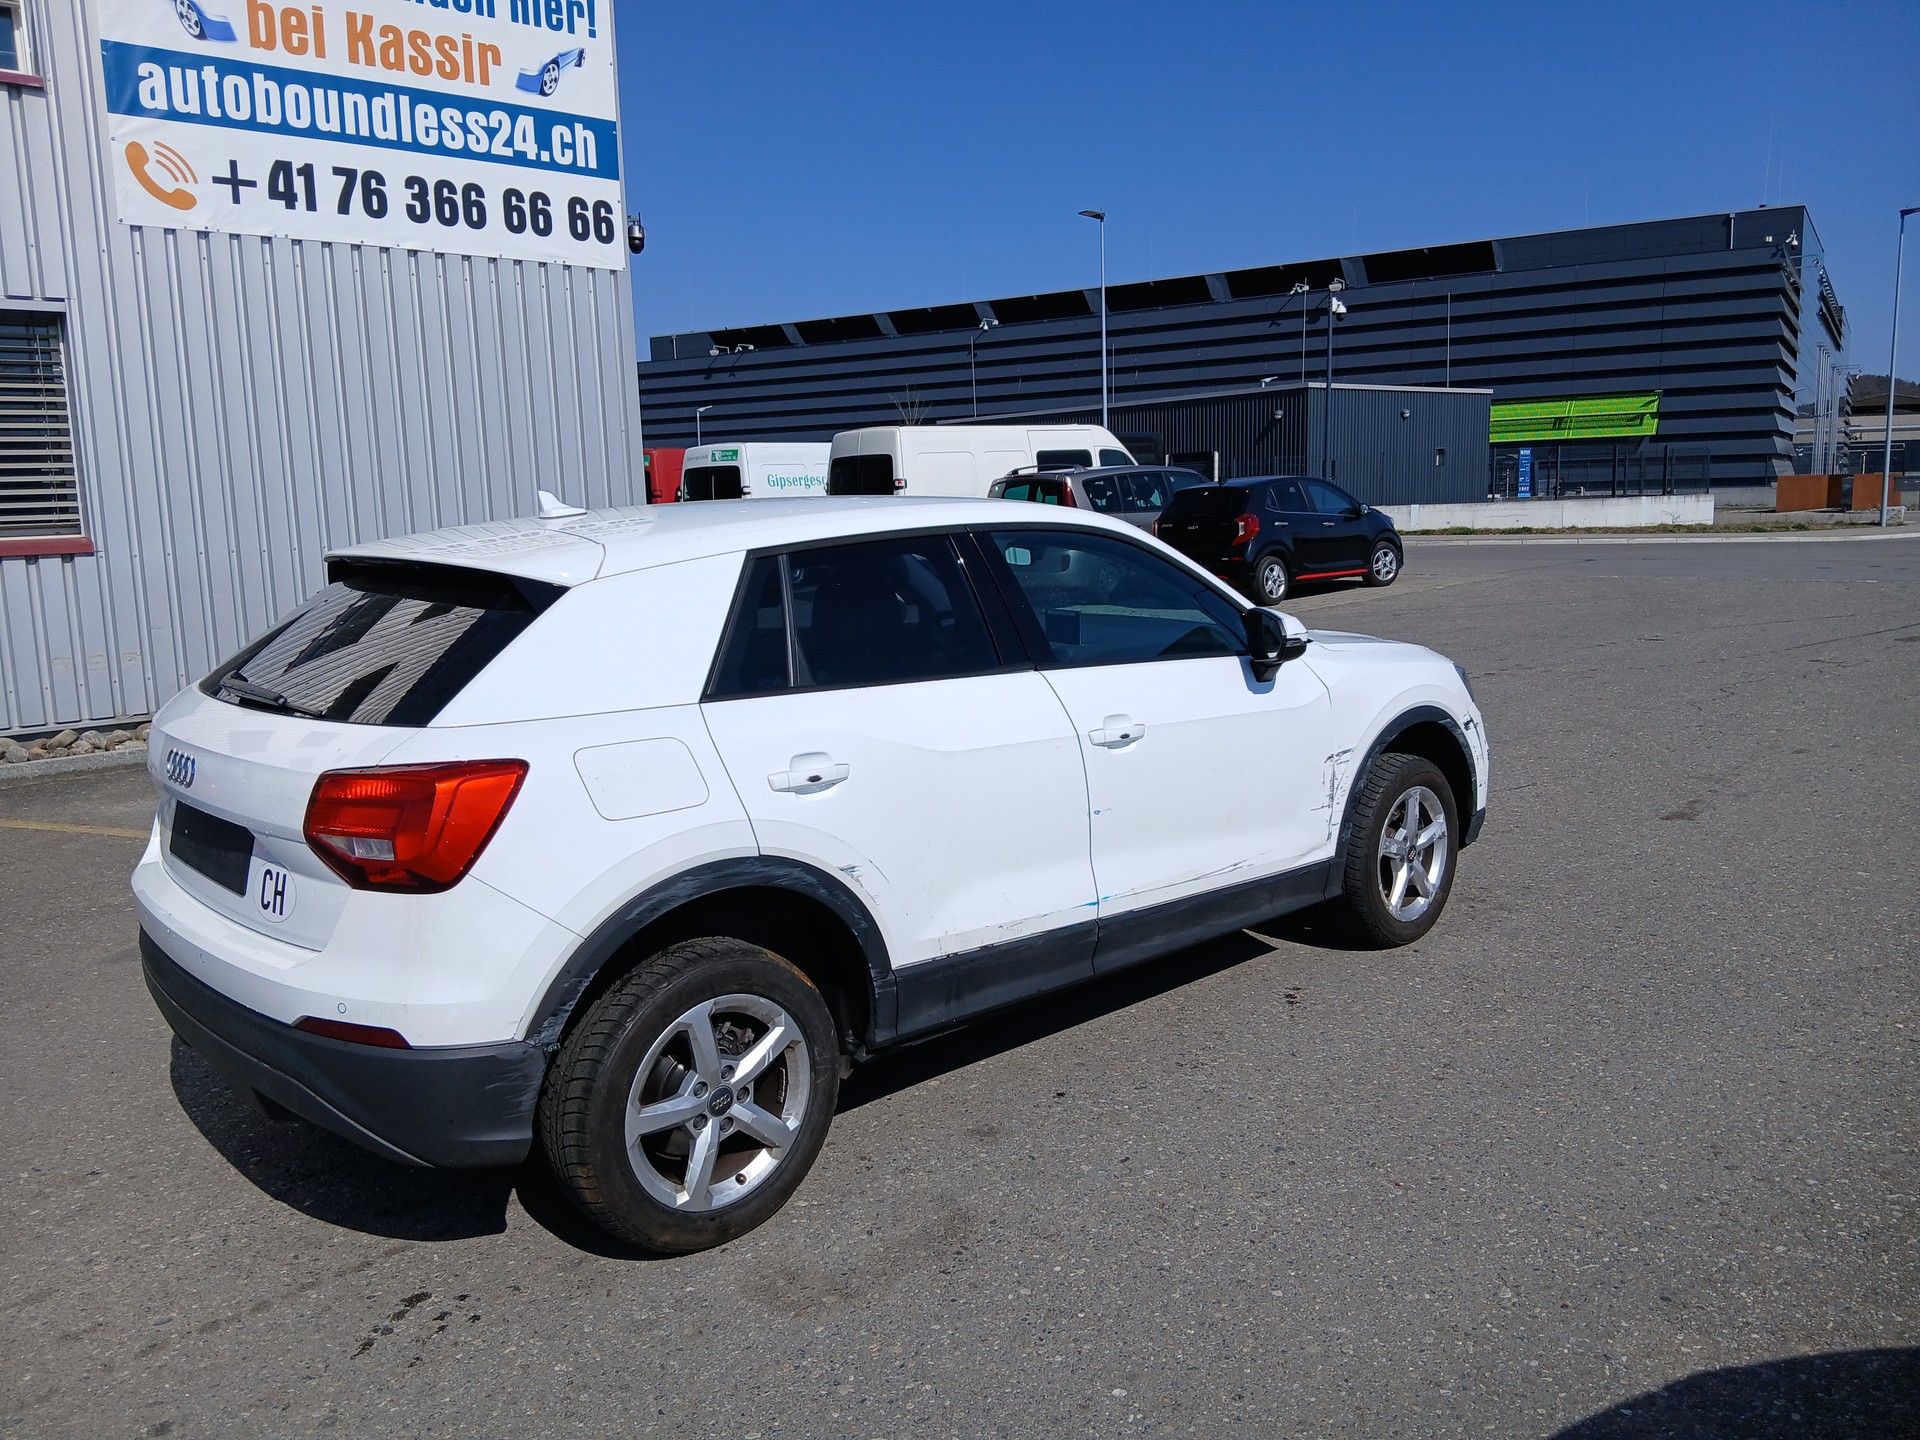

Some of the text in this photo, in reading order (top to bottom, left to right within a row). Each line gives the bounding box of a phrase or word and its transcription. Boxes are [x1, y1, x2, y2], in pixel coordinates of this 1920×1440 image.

[246, 0, 502, 86] bei Kassir
[138, 61, 598, 170] autoboundless24.ch
[331, 166, 389, 220] 76
[404, 175, 488, 230] 366
[502, 187, 553, 238] 66
[567, 196, 616, 245] 66
[260, 868, 287, 916] CH
